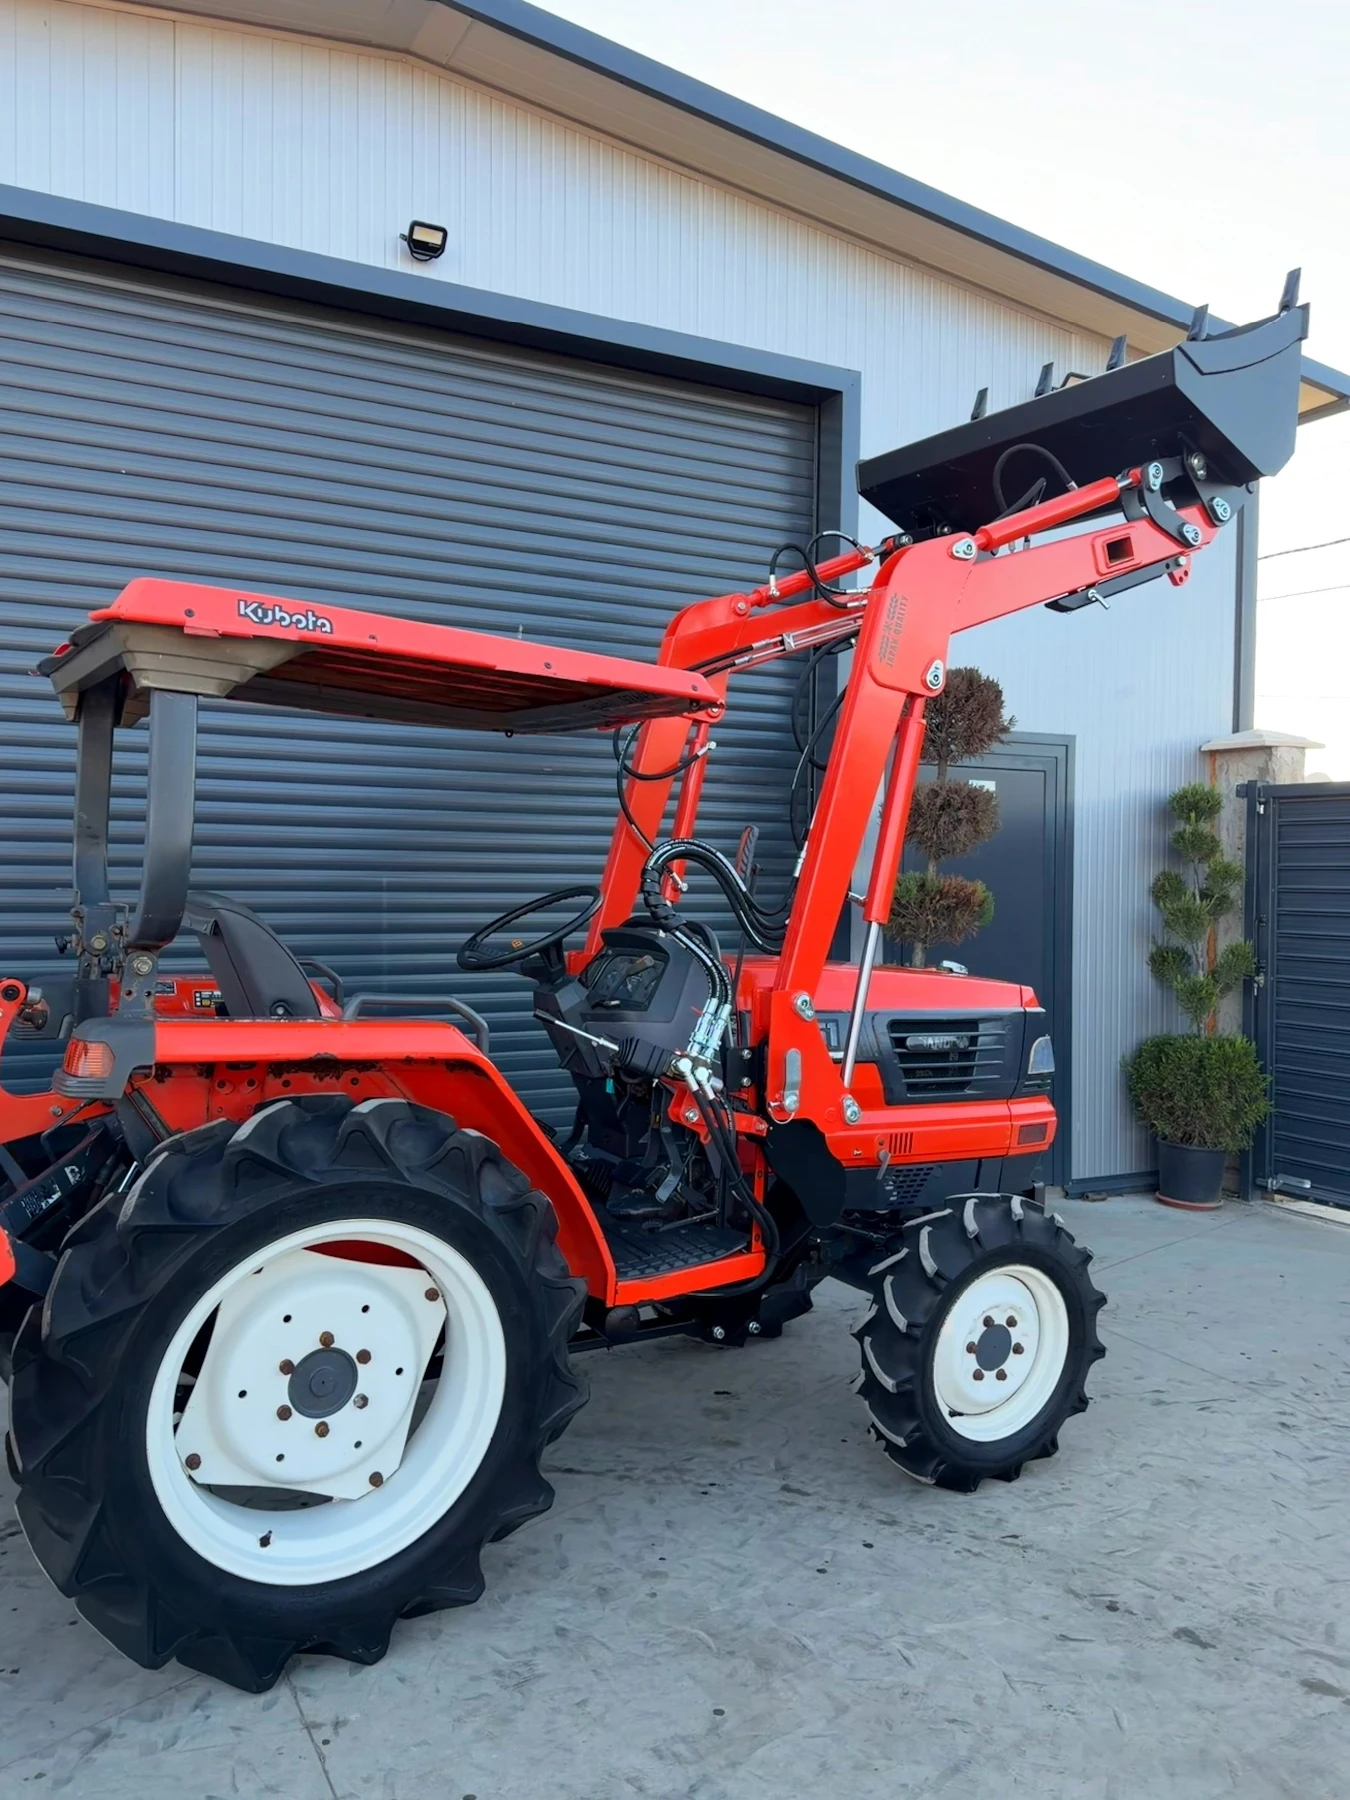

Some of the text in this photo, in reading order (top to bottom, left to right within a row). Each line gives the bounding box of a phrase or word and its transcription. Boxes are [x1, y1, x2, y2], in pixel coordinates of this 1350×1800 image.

[238, 600, 333, 634] Kubota
[886, 595, 908, 668] JAPAN QUALITY
